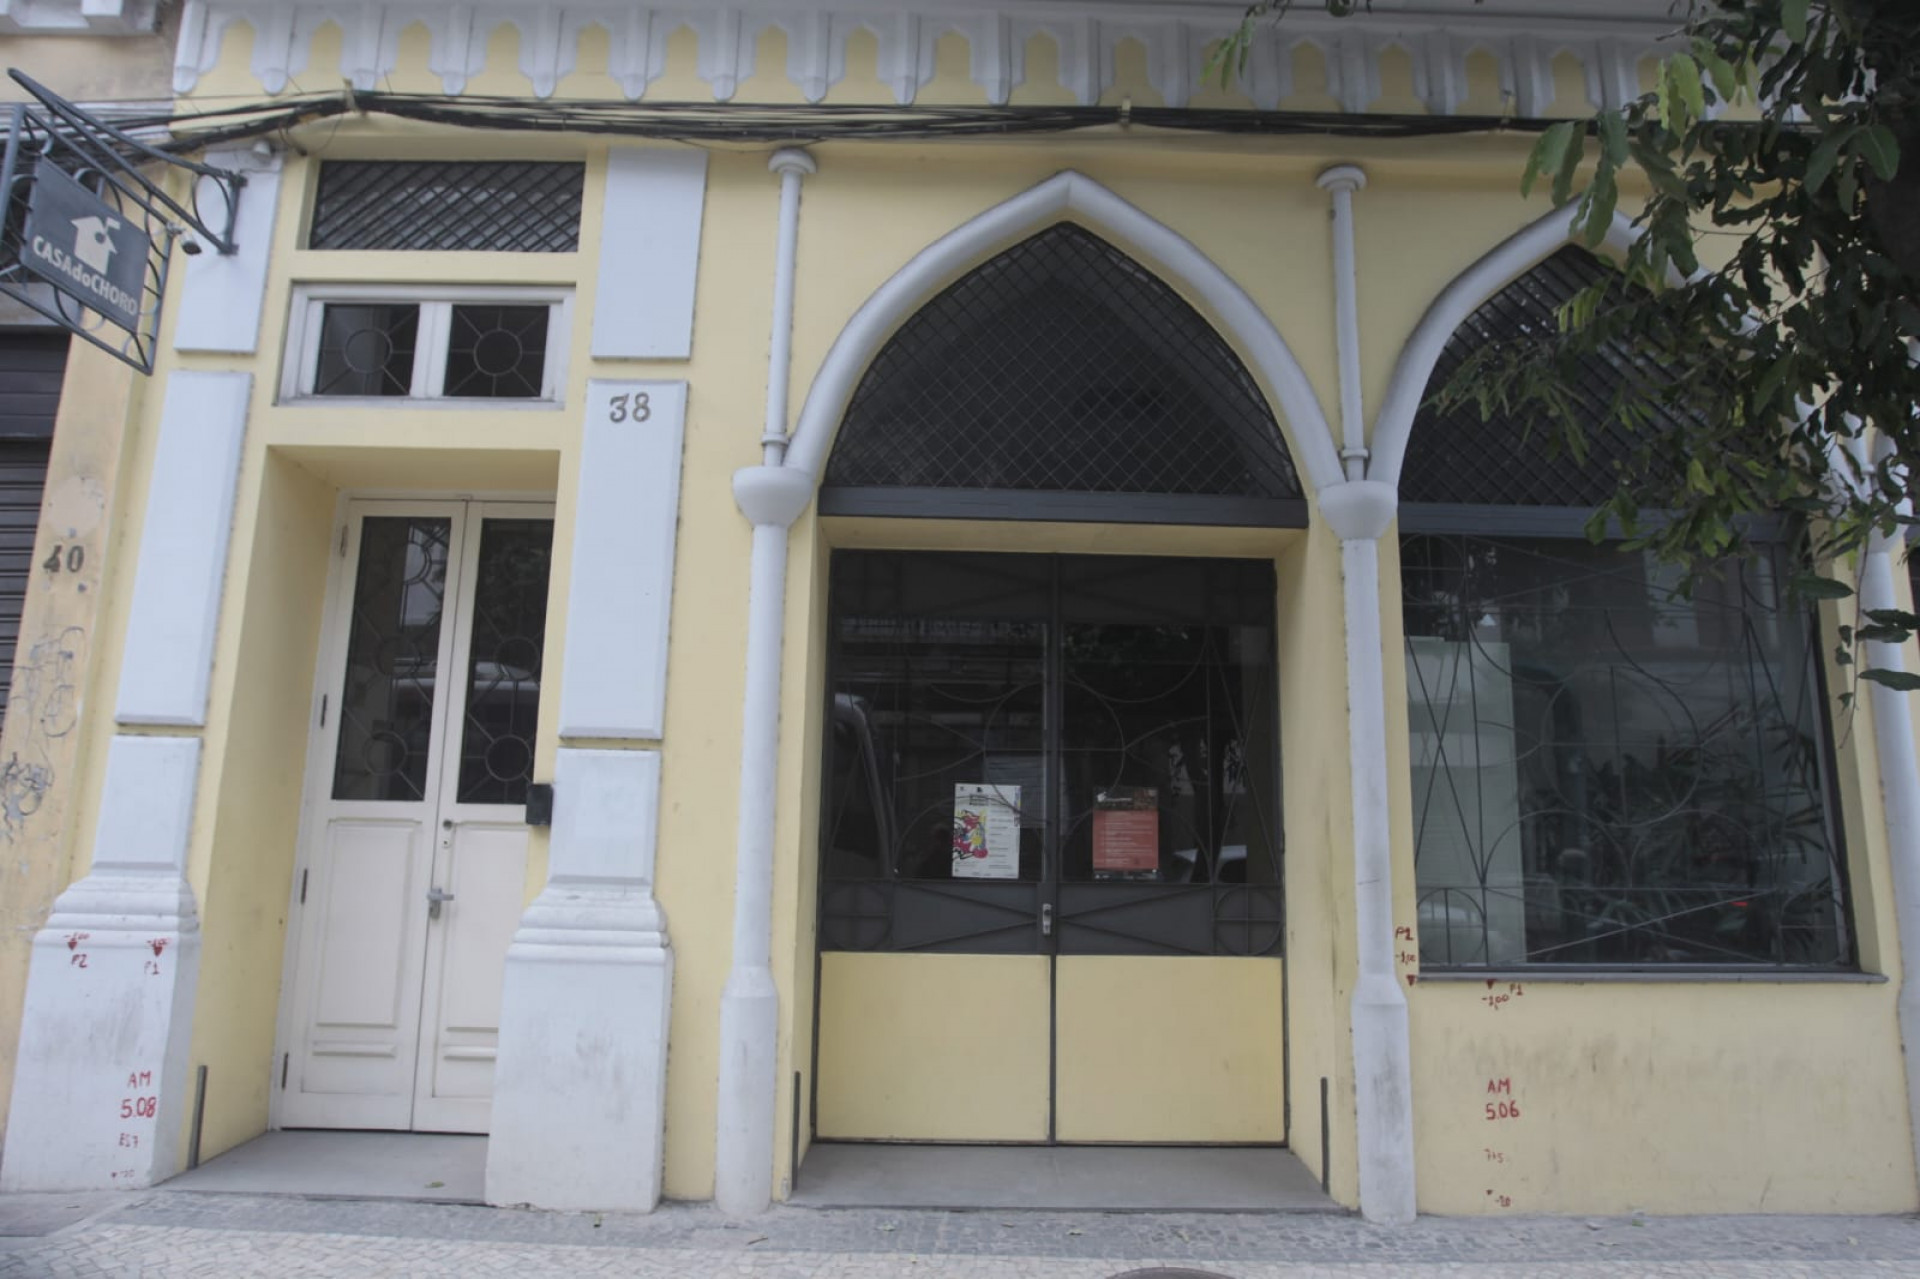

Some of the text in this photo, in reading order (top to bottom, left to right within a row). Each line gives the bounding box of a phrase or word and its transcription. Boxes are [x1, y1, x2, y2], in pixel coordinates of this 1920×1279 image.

[609, 391, 651, 423] 38
[43, 545, 85, 573] 40
[127, 1070, 152, 1089] AM
[1487, 1077, 1511, 1095] AM
